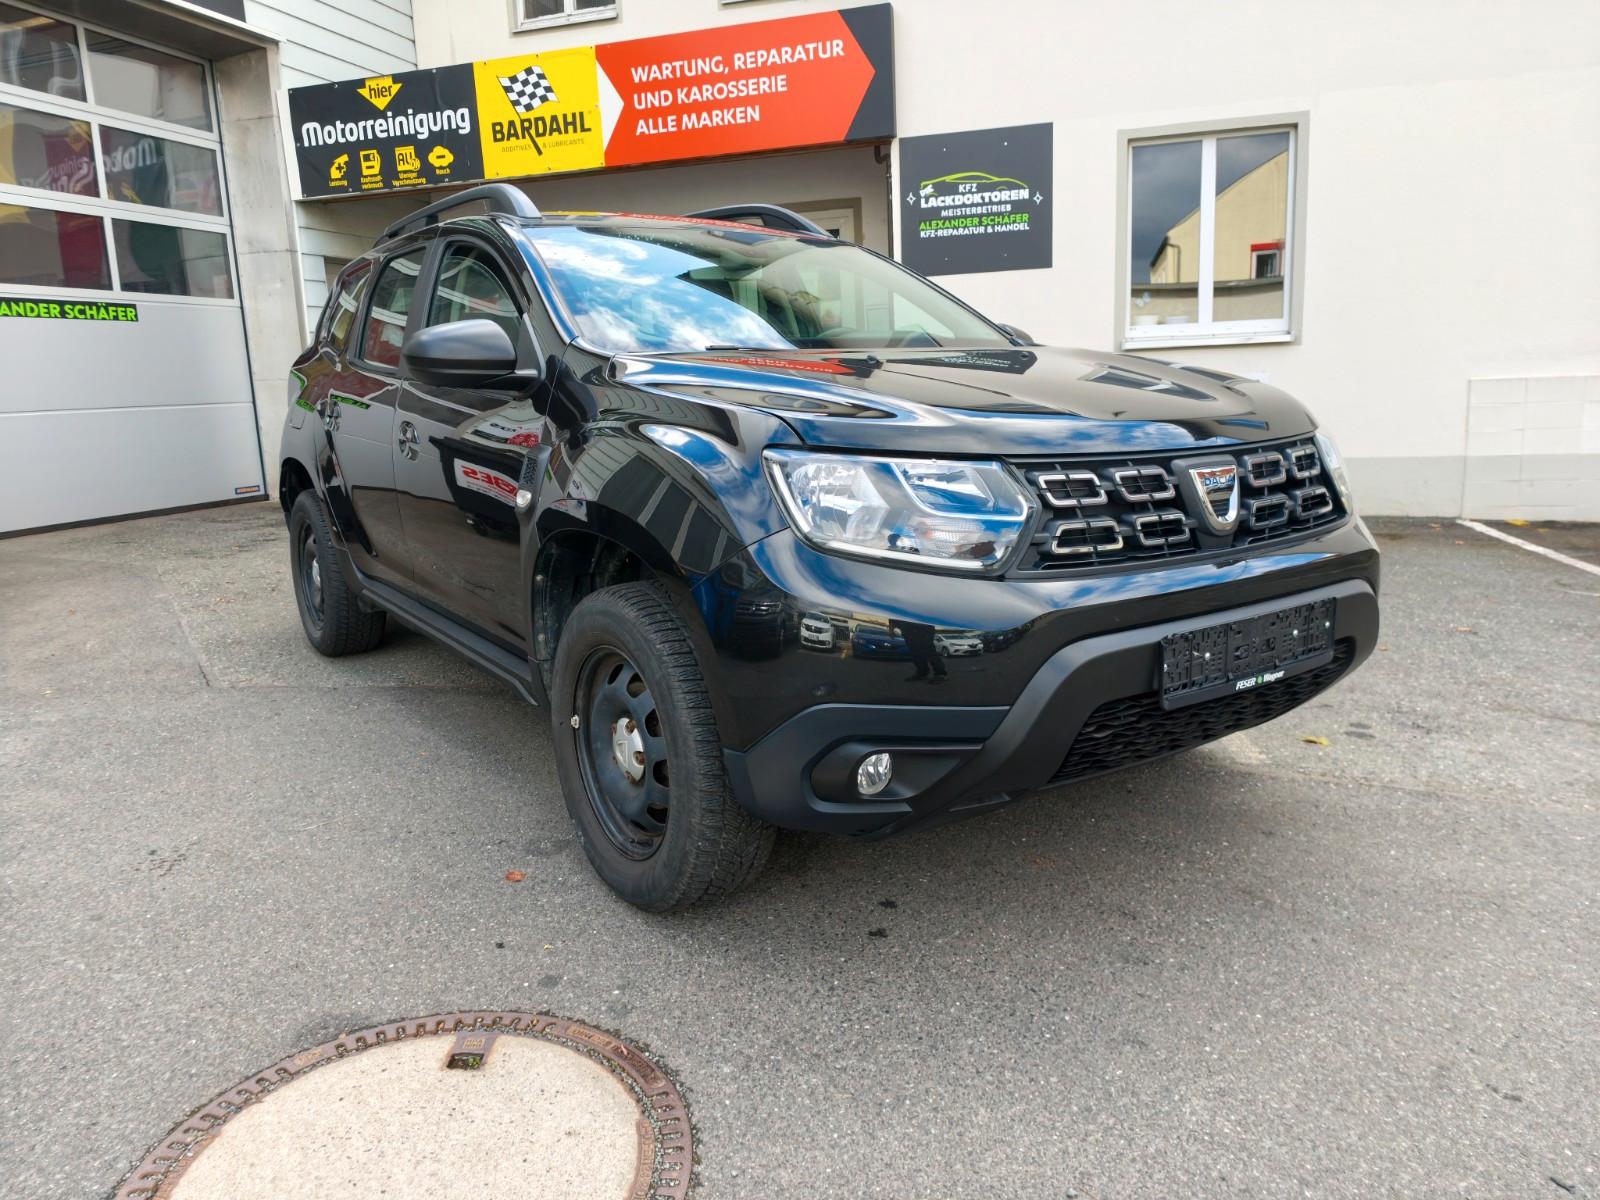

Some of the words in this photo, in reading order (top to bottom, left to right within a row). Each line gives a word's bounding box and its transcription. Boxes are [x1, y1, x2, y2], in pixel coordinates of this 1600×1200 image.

[631, 56, 729, 84] WARTUNG,
[734, 39, 845, 71] REPARATUR
[368, 84, 393, 99] hier
[633, 91, 673, 110] UND
[677, 74, 788, 105] KAROSSERIE
[301, 107, 471, 148] Motorreinigung
[491, 111, 592, 143] BARDAHL
[636, 116, 677, 136] ALLE
[682, 105, 760, 131] MARKEN
[958, 183, 978, 193] KFZ
[920, 189, 1030, 209] LACKDOKTOREN
[941, 204, 1012, 217] MEISTERBETRIEB
[919, 218, 979, 231] ALEXANDER
[982, 213, 1029, 225] SCHÄFER
[920, 226, 984, 238] KFZ-REPARATUR
[994, 223, 1030, 232] HANDEL
[0, 301, 61, 318] ANDER
[63, 302, 137, 321] SCHÄFER
